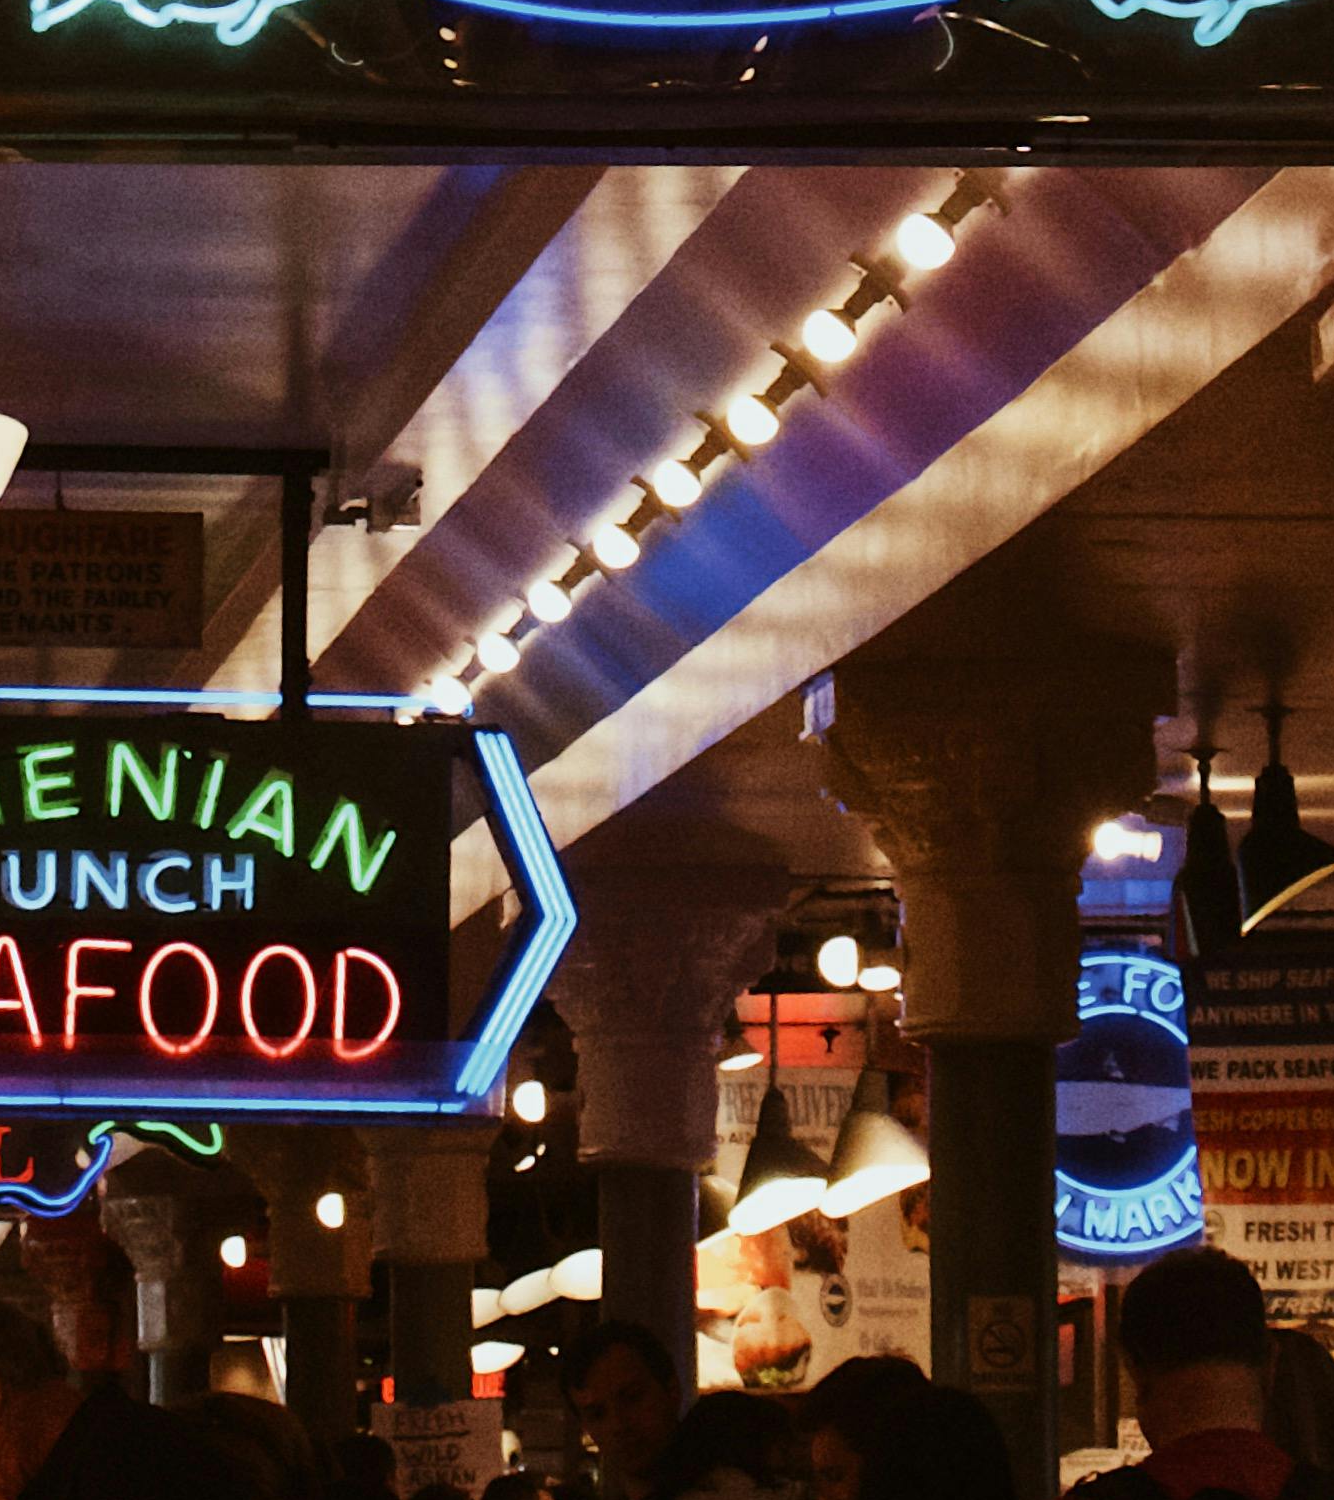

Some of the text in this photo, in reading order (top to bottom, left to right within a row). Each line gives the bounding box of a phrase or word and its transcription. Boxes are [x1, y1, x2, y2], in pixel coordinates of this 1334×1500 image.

[30, 561, 163, 584] PATRONS
[1122, 963, 1186, 1014] FO
[1204, 970, 1232, 992] WE
[1235, 968, 1282, 991] SHIP
[1191, 1003, 1294, 1028] ANYWHERE
[1298, 1003, 1318, 1024] IN
[1191, 1060, 1220, 1081] WE
[1227, 1059, 1278, 1080] PACK
[1201, 1148, 1292, 1190] NOW
[1082, 1174, 1203, 1240] MARK
[1243, 1220, 1316, 1242] FRESH
[1276, 1258, 1334, 1281] WEST
